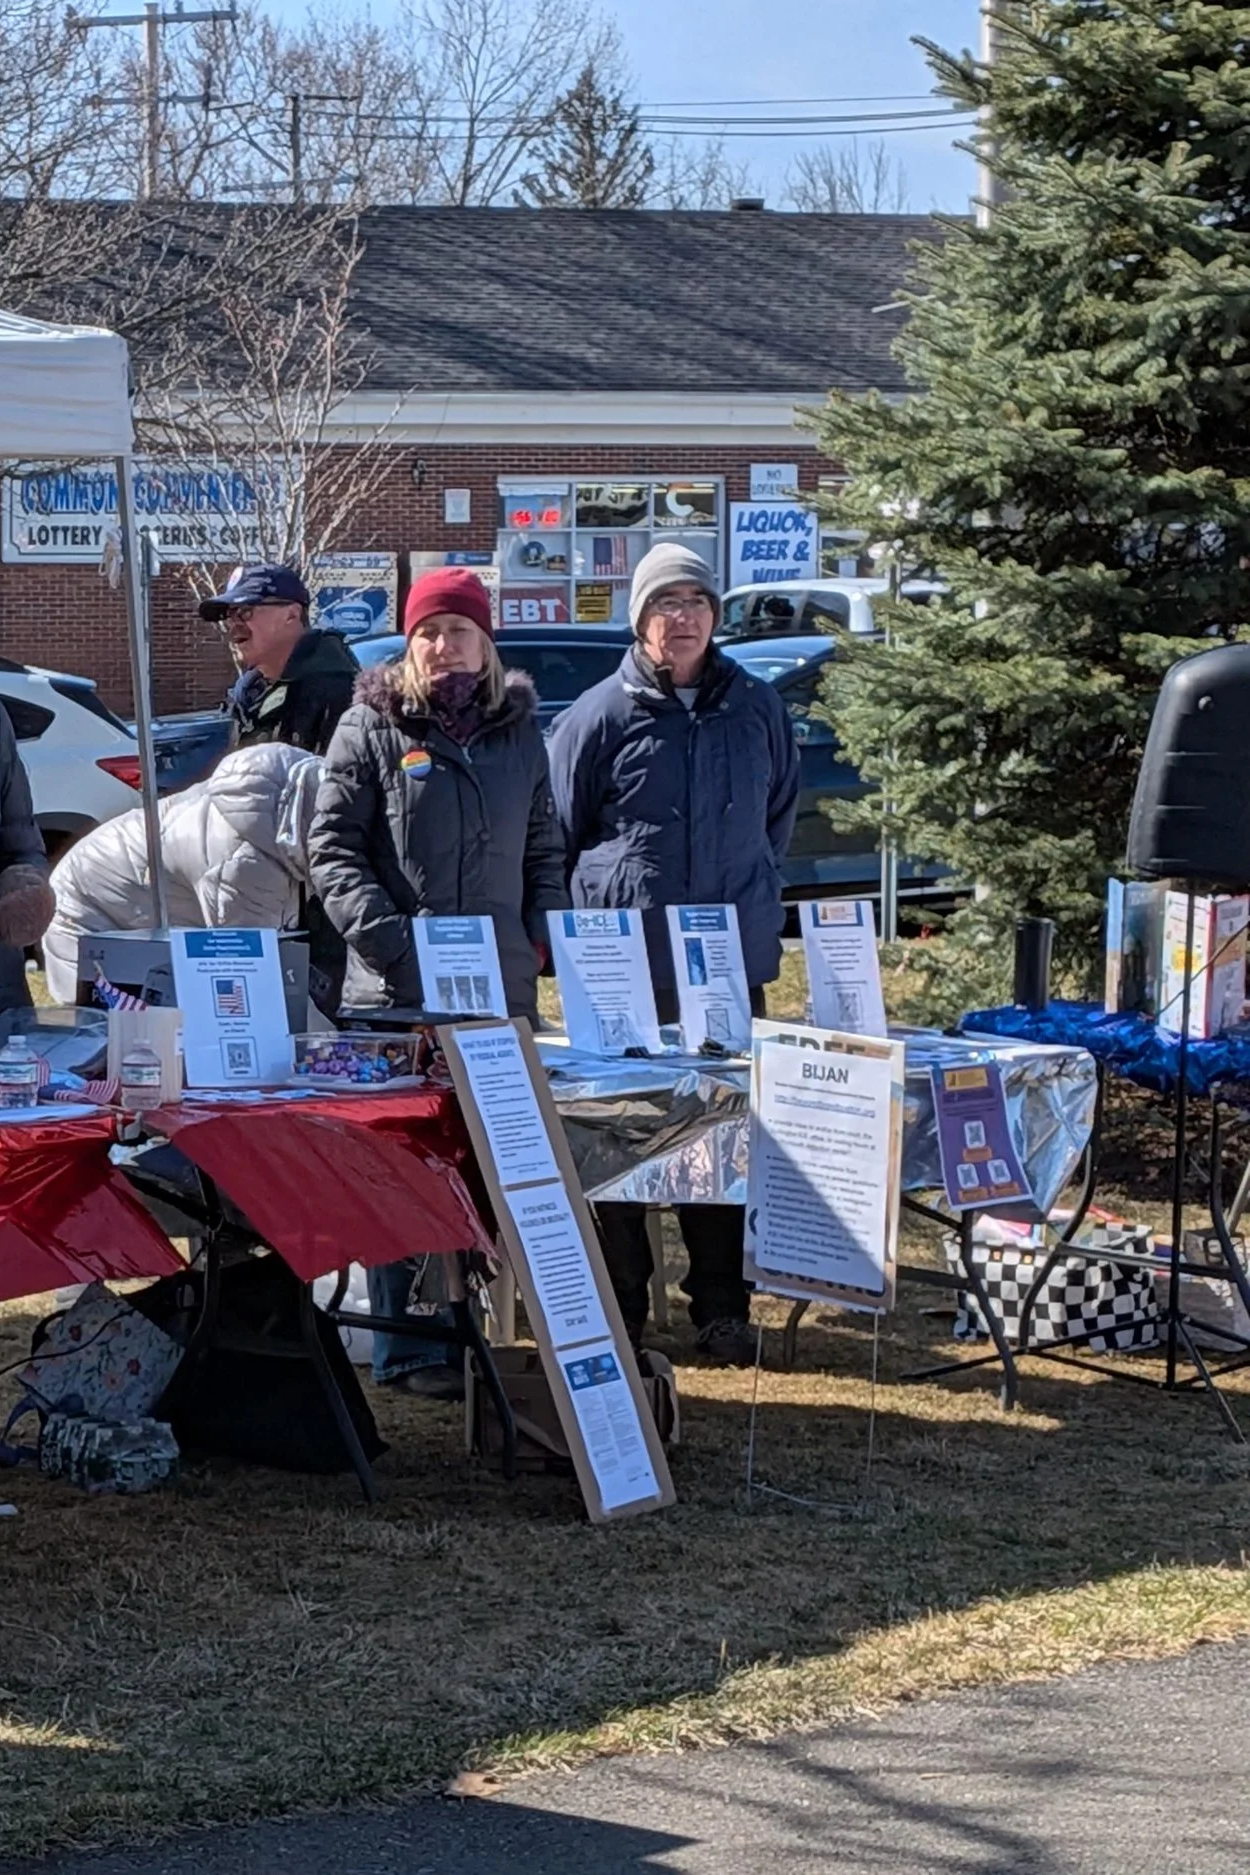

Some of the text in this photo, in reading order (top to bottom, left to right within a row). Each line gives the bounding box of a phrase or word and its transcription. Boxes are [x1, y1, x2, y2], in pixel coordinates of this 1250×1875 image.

[736, 509, 813, 537] LIQUOR,
[28, 525, 102, 546] LOTTERY
[741, 539, 810, 561] BEER &
[502, 599, 561, 622] EBT
[802, 1062, 849, 1084] BIJAN
